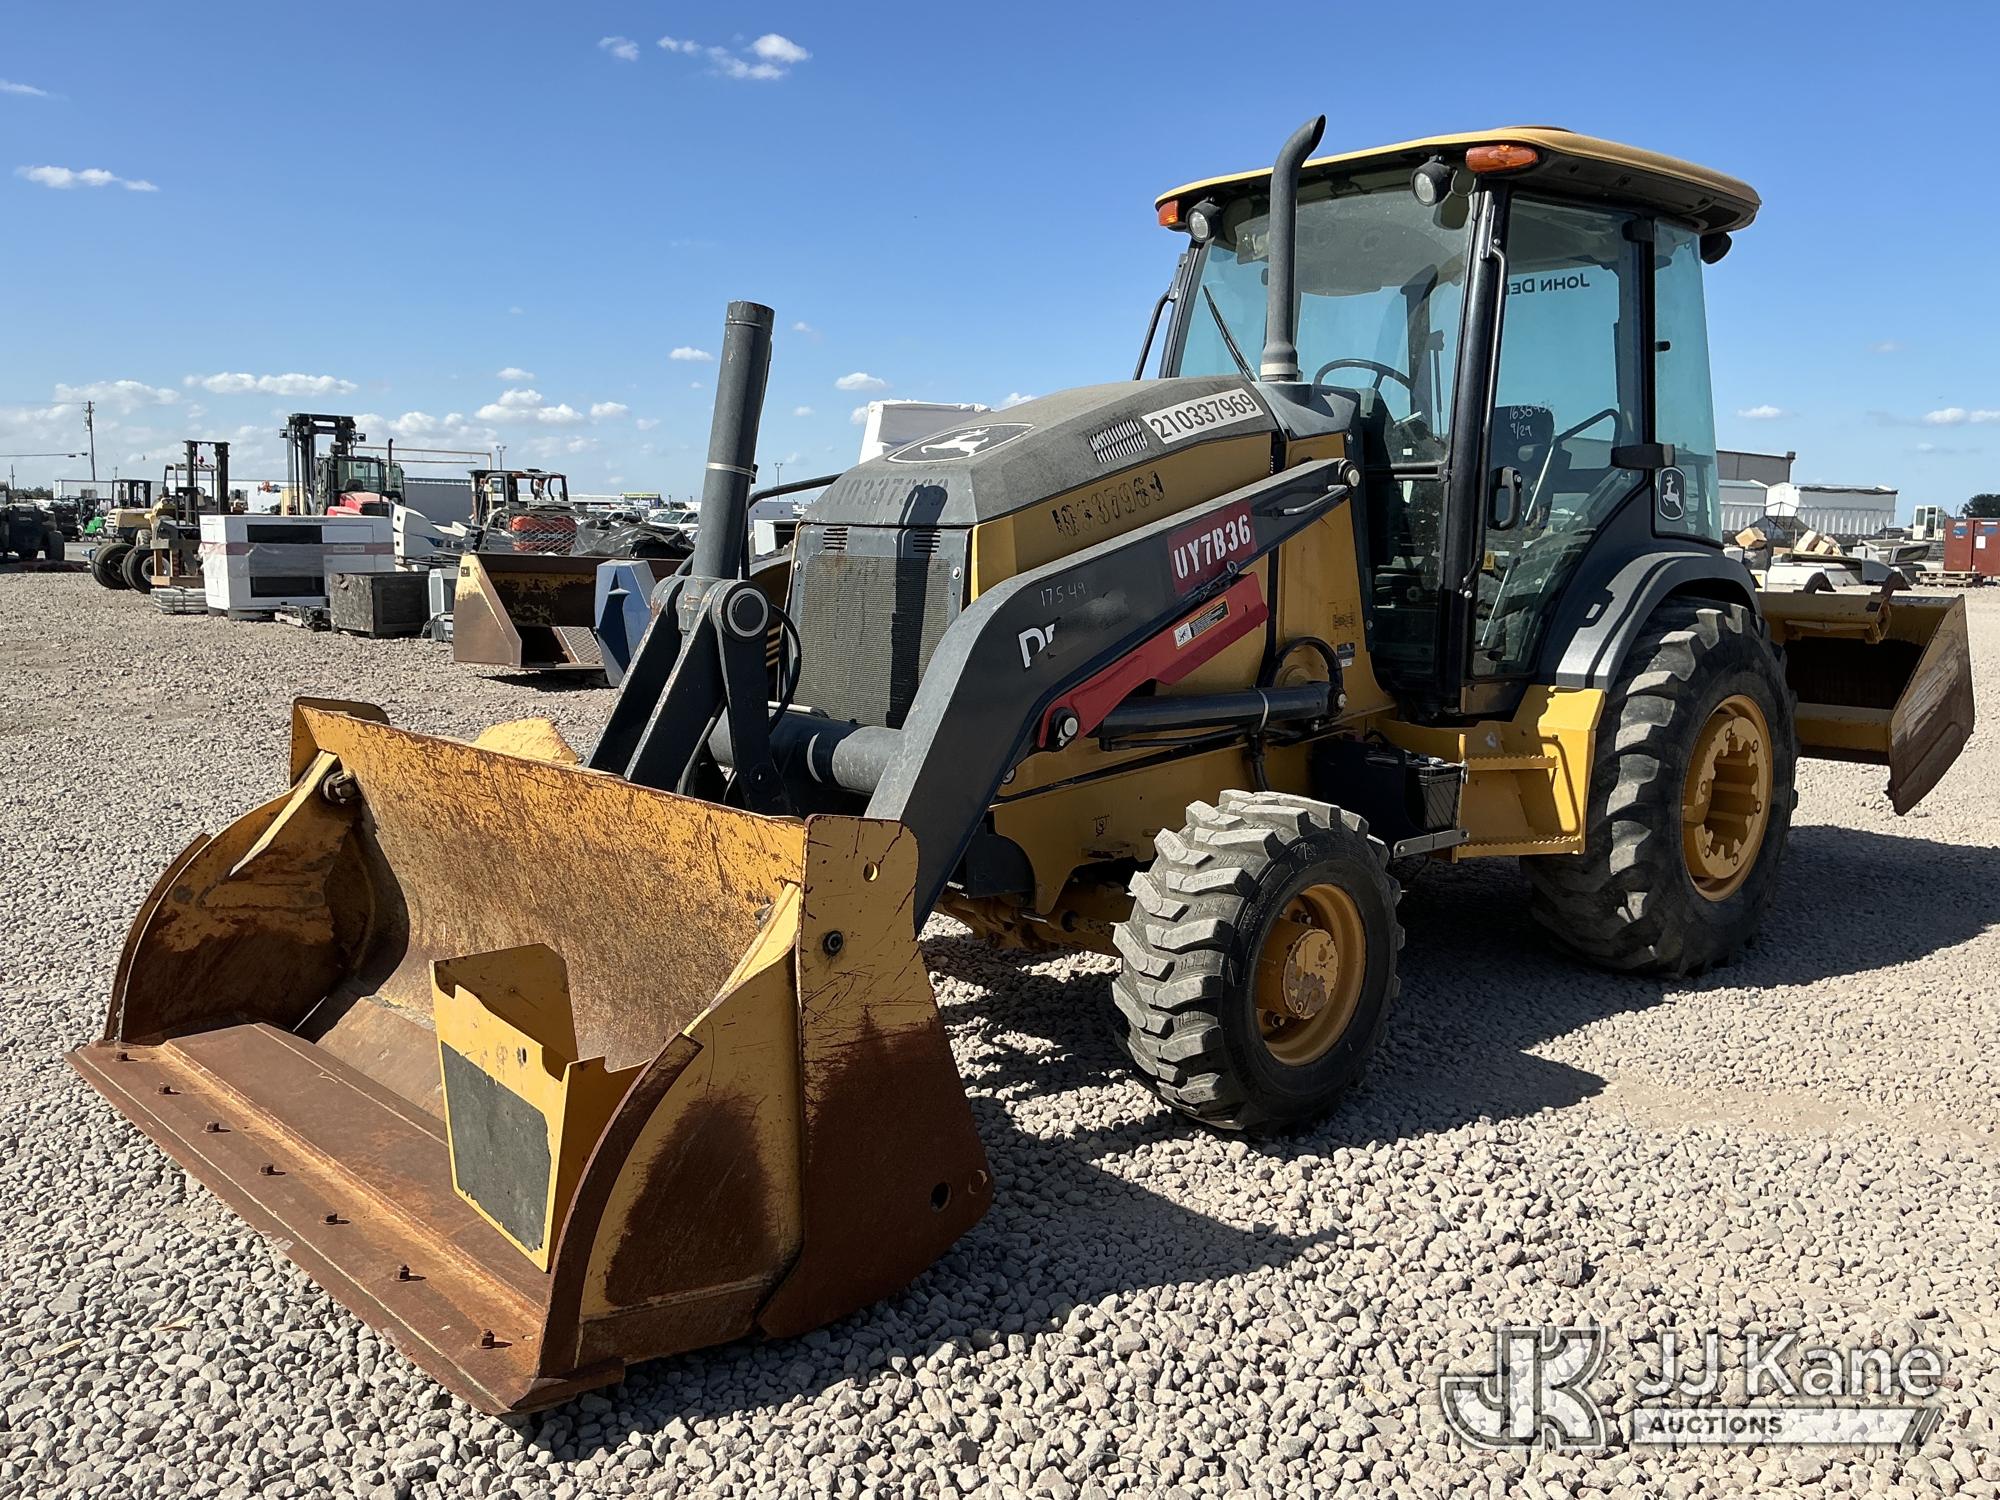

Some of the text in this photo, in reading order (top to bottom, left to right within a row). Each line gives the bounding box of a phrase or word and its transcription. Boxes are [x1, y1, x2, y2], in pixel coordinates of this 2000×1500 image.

[1150, 393, 1257, 439] 210337969
[1173, 514, 1251, 579] UY7B36
[1041, 582, 1087, 607] 17549
